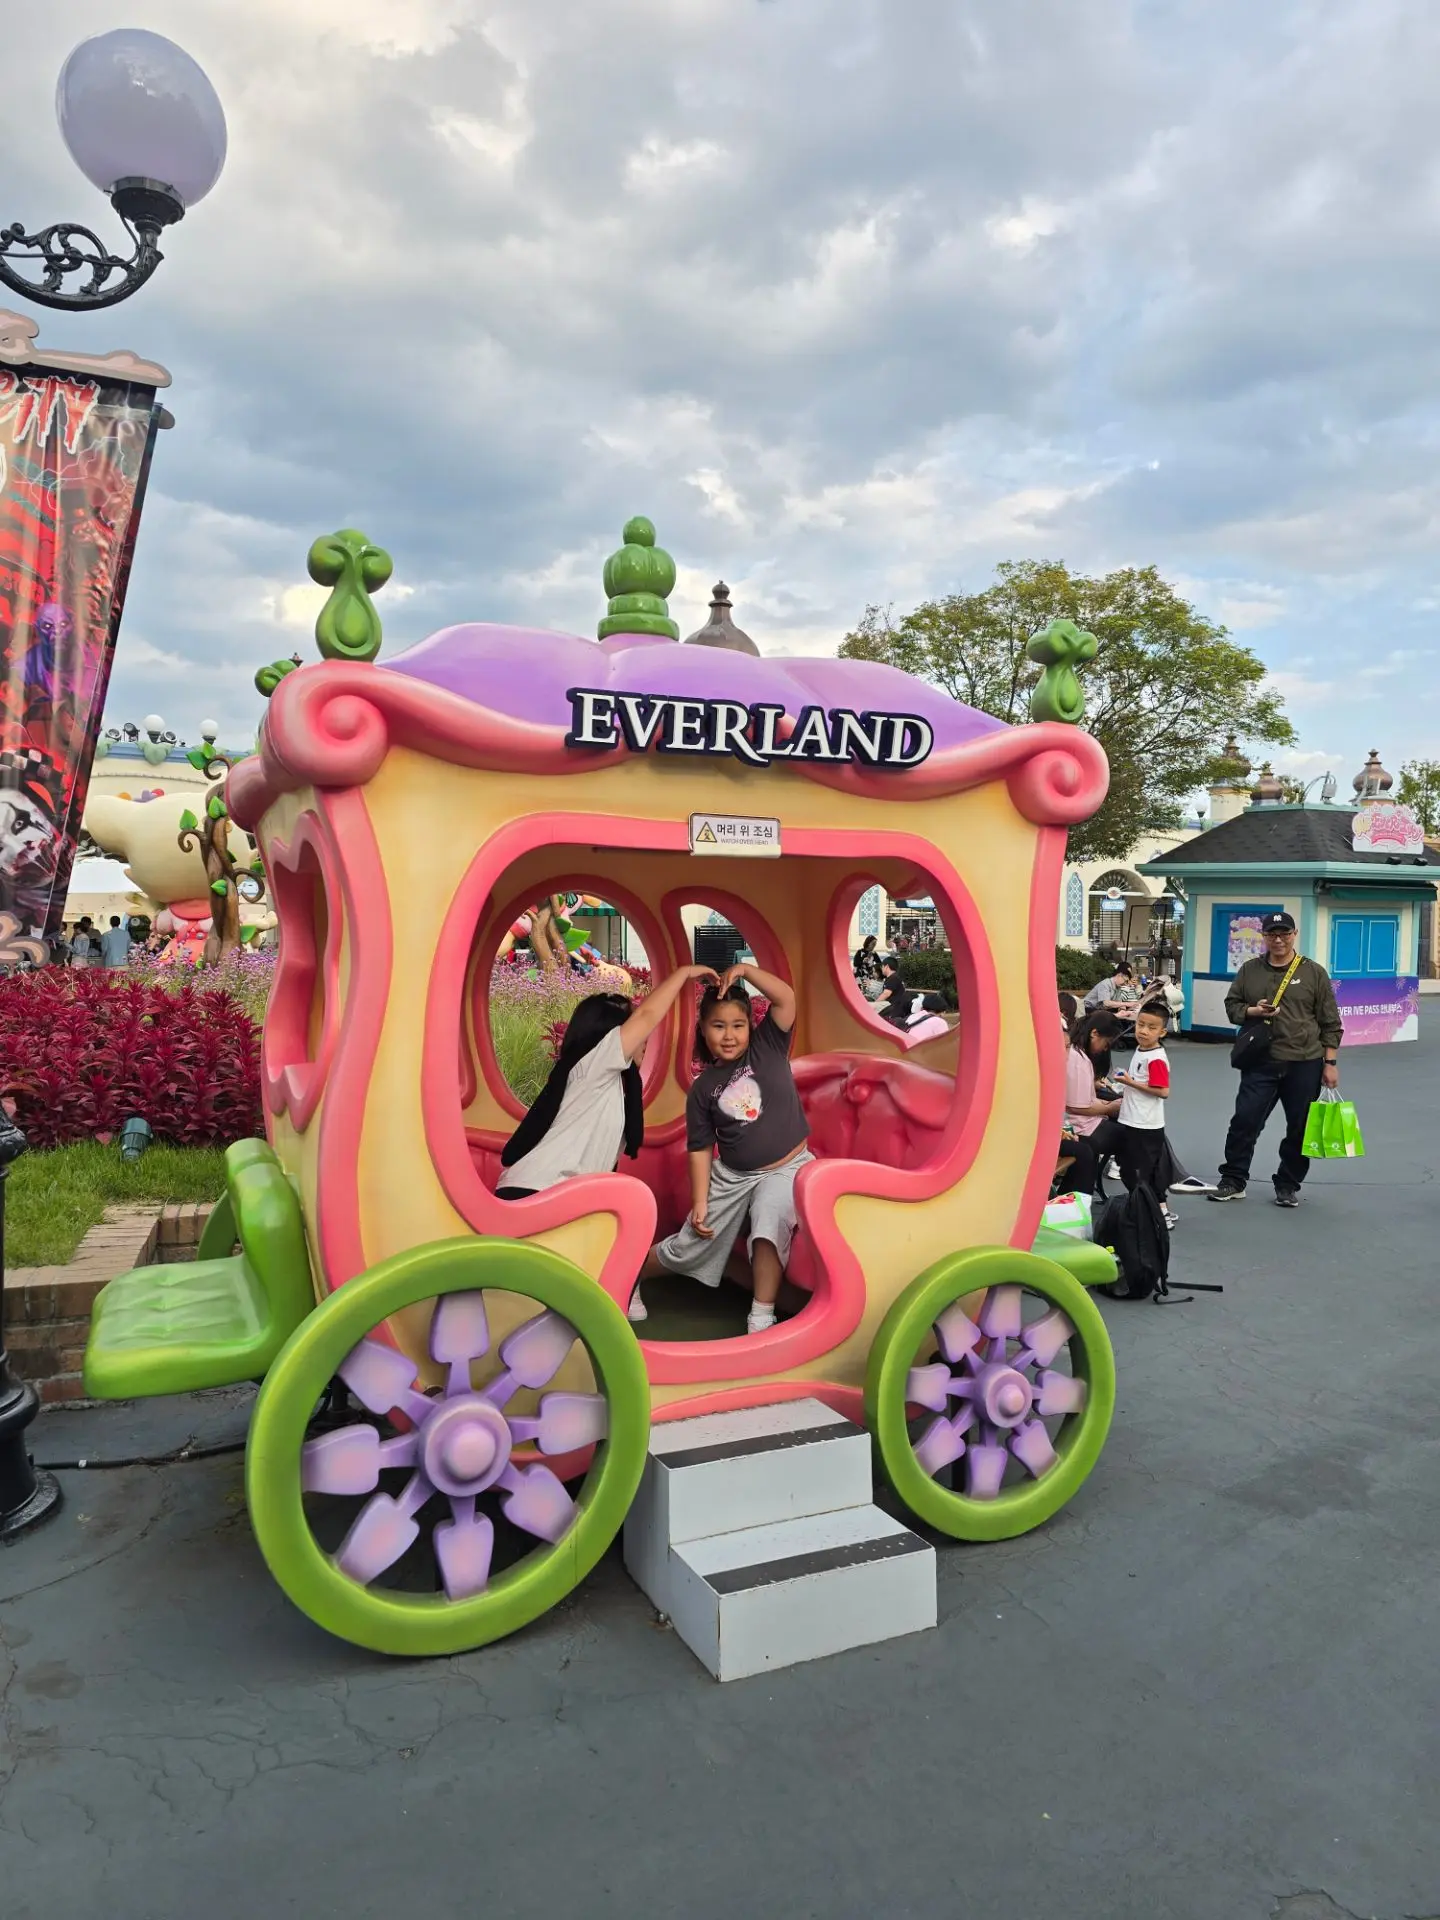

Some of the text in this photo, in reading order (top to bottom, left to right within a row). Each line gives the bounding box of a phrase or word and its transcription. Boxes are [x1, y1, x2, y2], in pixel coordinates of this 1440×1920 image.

[573, 691, 933, 764] EVERLAND
[717, 824, 772, 837] 머리 위 조심
[1365, 1005, 1379, 1015] PASS
